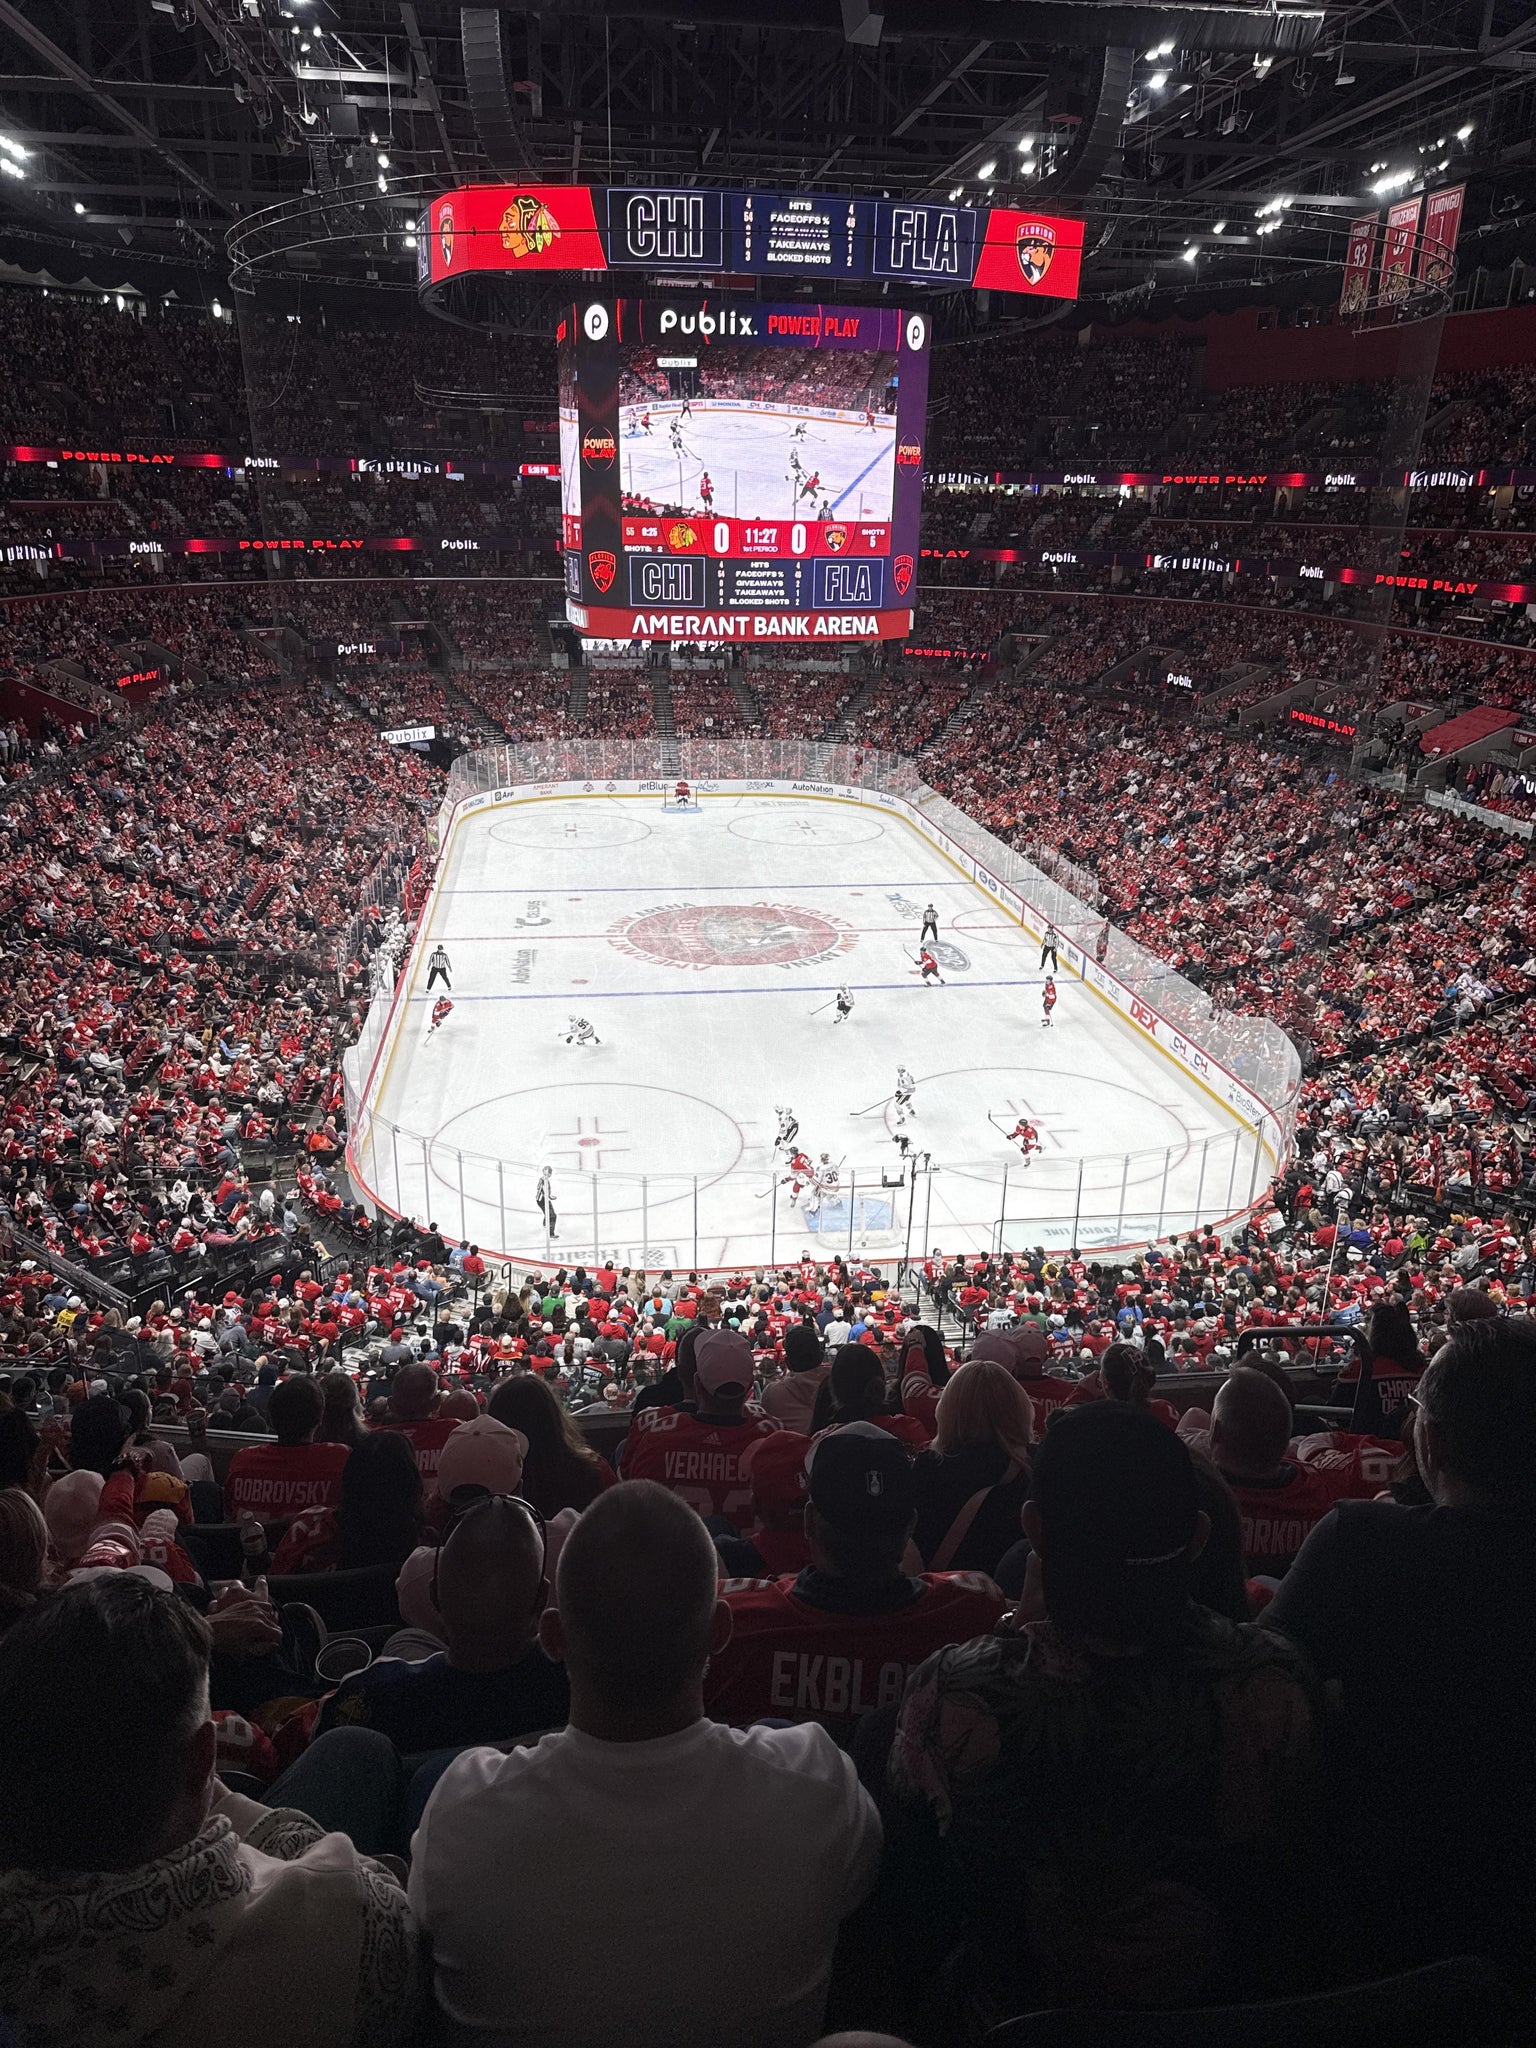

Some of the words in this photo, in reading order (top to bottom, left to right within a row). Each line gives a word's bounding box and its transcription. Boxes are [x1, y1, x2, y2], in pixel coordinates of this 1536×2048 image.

[789, 201, 812, 211] HITS
[1430, 192, 1461, 215] LUONGO
[743, 211, 753, 222] 54
[770, 214, 821, 224] FACEOFFS
[627, 195, 704, 258] CHI
[1020, 225, 1053, 239] FLORIDA
[769, 240, 831, 251] TAKEAWAYS
[891, 209, 958, 273] FLA
[767, 253, 803, 263] BLOCKED
[804, 254, 831, 264] SHOTS
[1353, 243, 1368, 267] 93
[768, 315, 820, 336] POWER
[825, 317, 860, 338] PLAY
[661, 359, 692, 367] Publix
[584, 438, 615, 449] POWER
[582, 448, 617, 458] PLAY
[898, 445, 921, 455] POWER
[62, 451, 122, 462] POWER
[126, 453, 175, 464] PLAY
[896, 455, 922, 465] PLAY
[1162, 475, 1219, 484] POWER
[1225, 476, 1268, 484] PLAY
[713, 522, 730, 554] 0
[745, 528, 777, 544] 11:27
[861, 528, 885, 536] SHOTS
[239, 540, 304, 549] POWER
[312, 540, 364, 549] PLAY
[791, 523, 807, 554] 0
[869, 536, 876, 548] 5
[920, 549, 970, 558] PLAY
[642, 563, 693, 600] CHI
[825, 565, 872, 601] FLA
[1375, 574, 1428, 589] POWER
[1433, 580, 1478, 595] PLAY
[632, 614, 750, 636] AMERANT
[754, 615, 810, 636] BANK
[813, 615, 879, 636] ARENA
[905, 647, 952, 658] POWER
[133, 669, 158, 683] PLAY
[1291, 710, 1326, 729] POWER
[1328, 720, 1356, 736] PLAY
[386, 730, 427, 742] Publix
[638, 781, 669, 792] jetBlue
[792, 783, 833, 794] AutoNation
[752, 901, 854, 931] AMERANT
[1129, 999, 1160, 1035] DEX
[826, 1171, 838, 1184] 30
[802, 1267, 815, 1279] 72
[234, 1478, 332, 1504] BOBROVSKY
